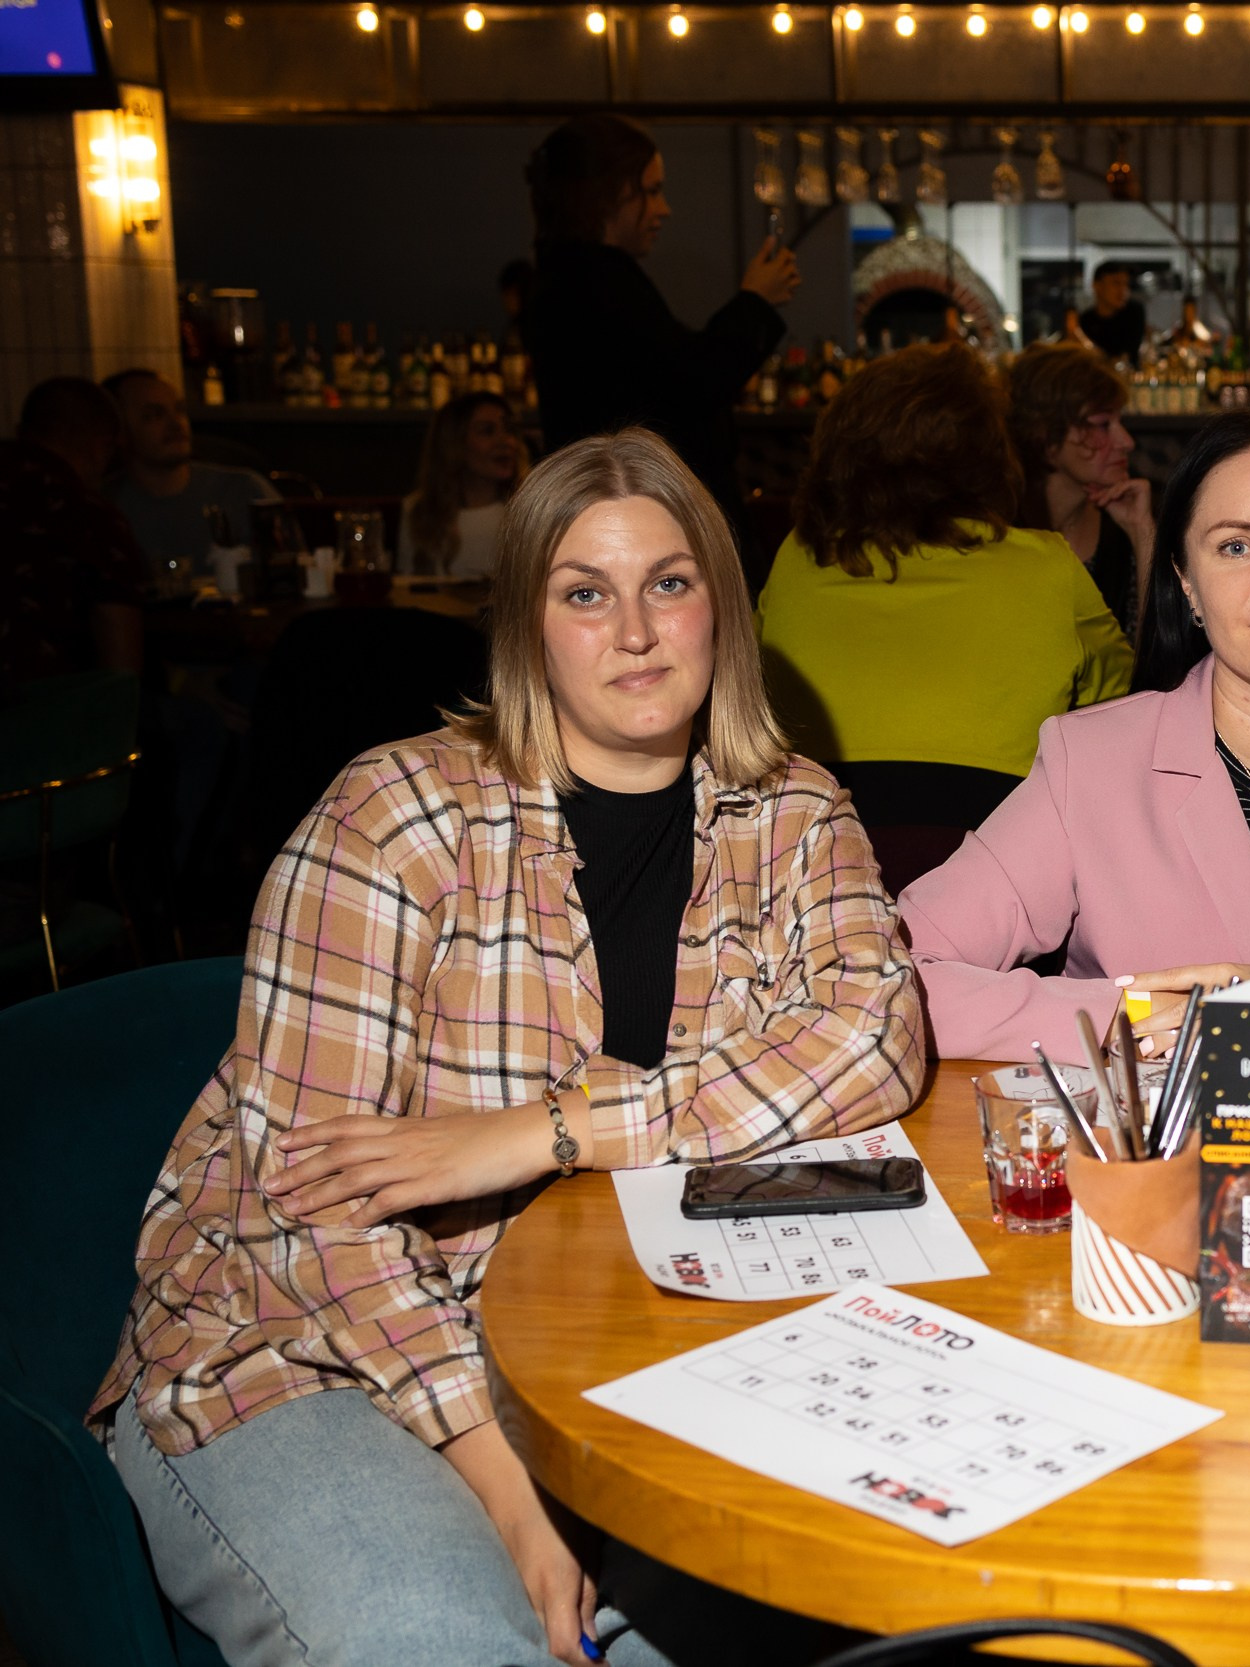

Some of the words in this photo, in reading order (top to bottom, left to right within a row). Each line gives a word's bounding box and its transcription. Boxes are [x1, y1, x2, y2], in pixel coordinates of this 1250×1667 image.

[781, 1226, 801, 1237] 53
[832, 1236, 852, 1247] 63
[737, 1232, 757, 1241] 51
[749, 1262, 770, 1272] 77
[794, 1257, 816, 1268] 70
[802, 1273, 822, 1285] 86
[843, 1296, 975, 1350] ПойЛОТО
[805, 1402, 836, 1417] 32
[809, 1372, 840, 1386] 20
[844, 1386, 874, 1400] 34
[918, 1414, 948, 1429] 53
[995, 1444, 1027, 1460] 70
[922, 1384, 951, 1396] 47
[994, 1413, 1026, 1427] 63
[1072, 1442, 1106, 1456] 89
